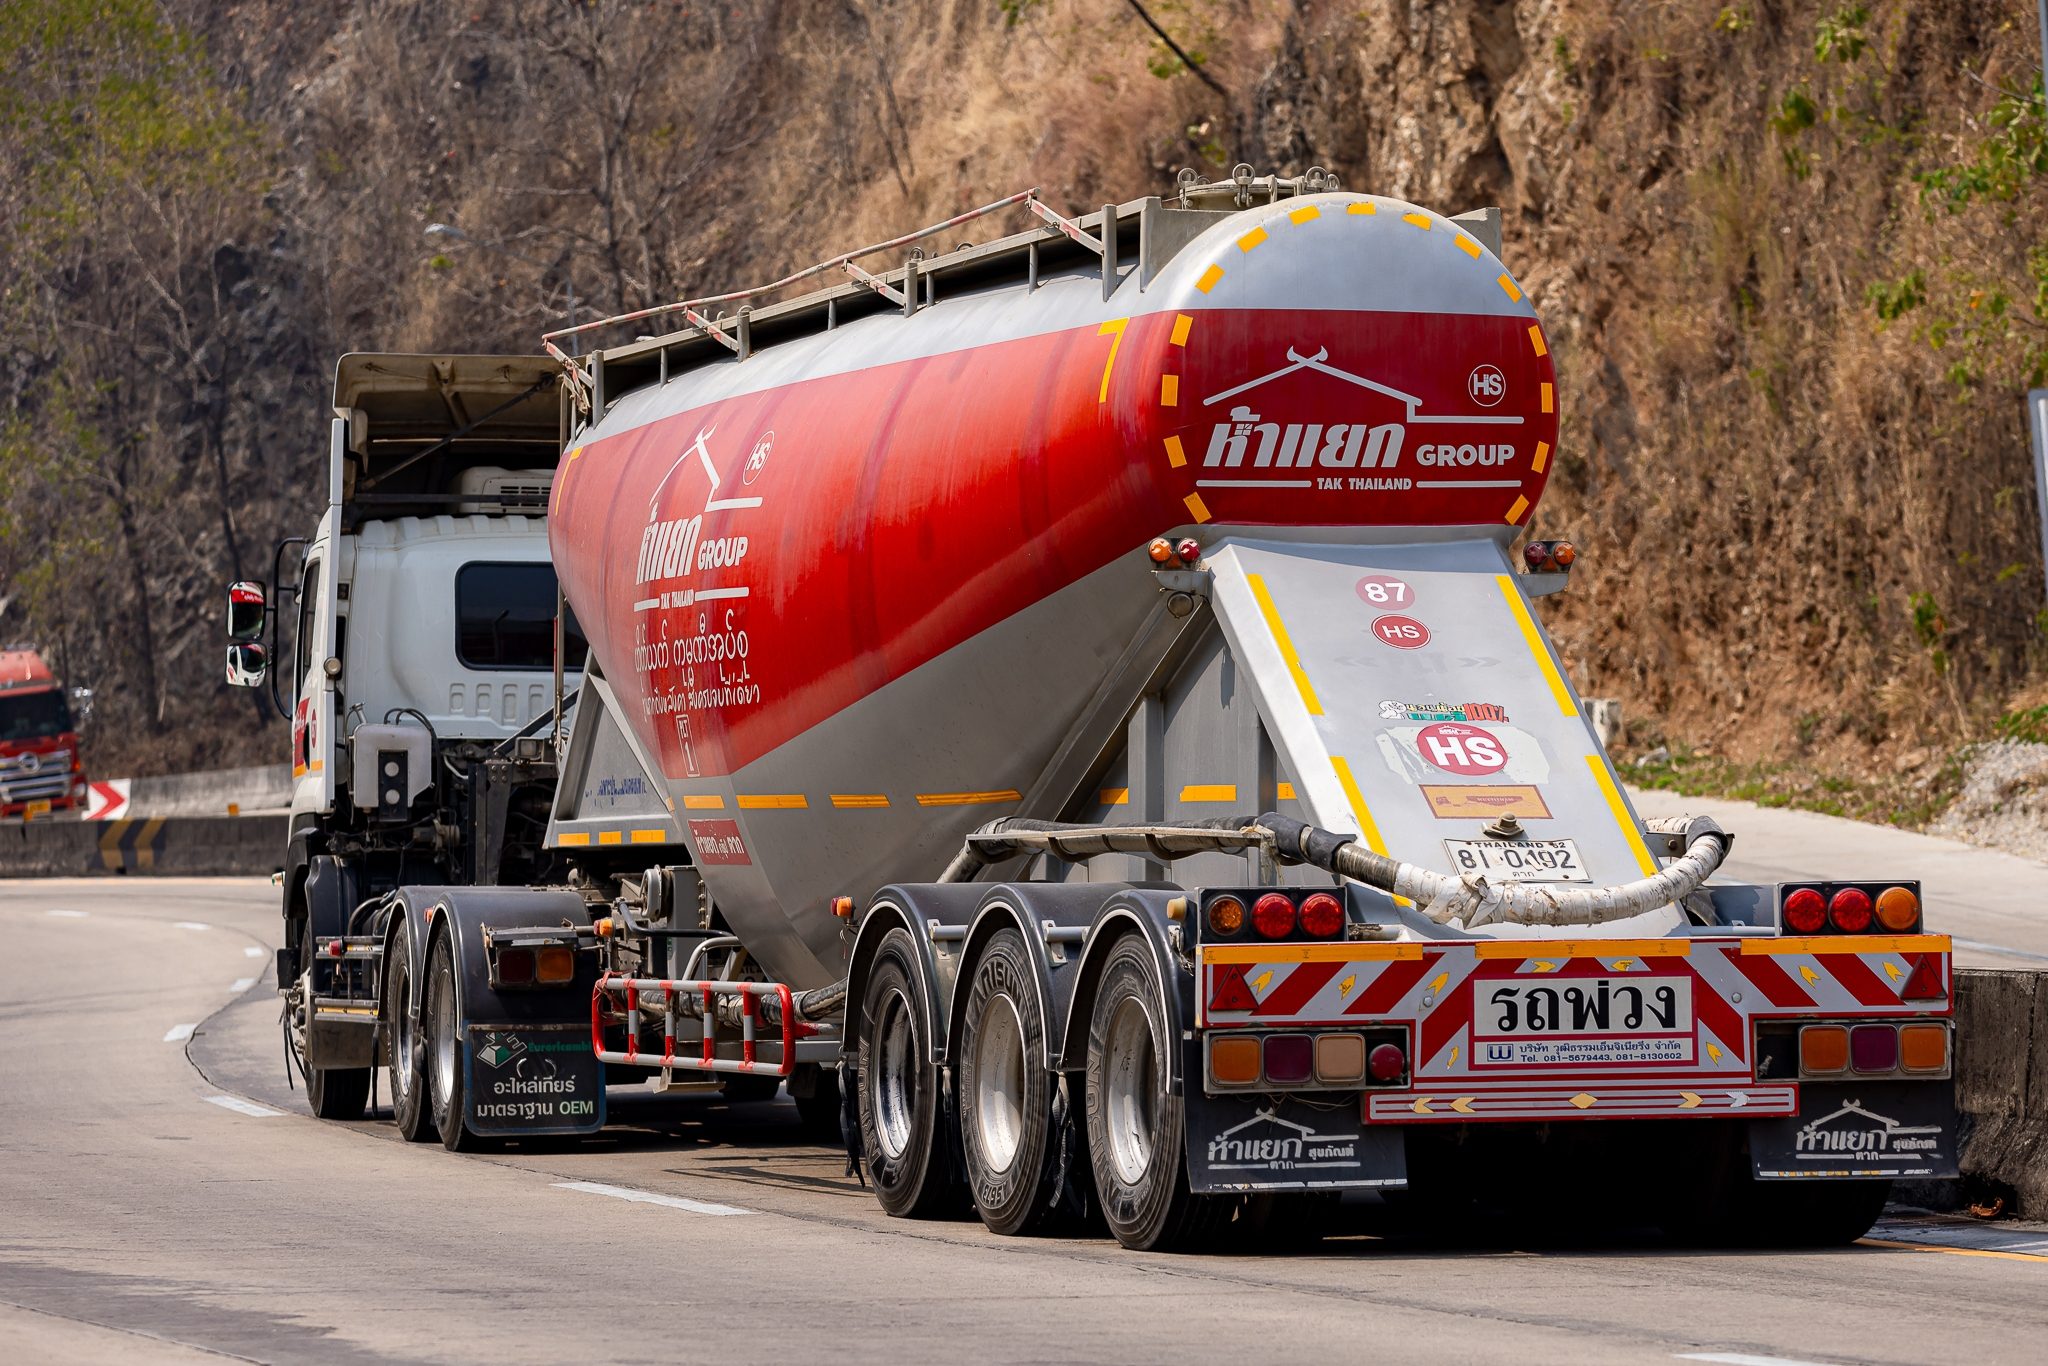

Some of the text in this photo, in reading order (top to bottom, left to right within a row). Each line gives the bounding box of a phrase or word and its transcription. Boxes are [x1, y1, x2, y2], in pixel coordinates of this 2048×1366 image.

[1203, 405, 1406, 468] ห้าแยก
[1416, 443, 1515, 466] GROUP
[1316, 477, 1412, 491] TAK THAILAND
[635, 502, 703, 586] ห้าแยก
[697, 536, 749, 571] GROUP
[1363, 582, 1406, 602] 87
[1381, 624, 1421, 639] HS
[1425, 736, 1505, 767] HS
[1474, 841, 1544, 849] THAILAND
[1491, 980, 1676, 1032] รถพ่วง
[1519, 1042, 1549, 1053] บริษัท
[1655, 1041, 1681, 1050] จำกัด
[1520, 1054, 1539, 1063] Tel.
[1616, 1052, 1682, 1061] 081-8130602
[494, 1074, 576, 1095] อะไหล่เกียร์
[477, 1101, 553, 1120] มาตราฐาน
[559, 1100, 594, 1115] OEM
[1796, 1124, 1889, 1151] ห้าแยก
[1207, 1135, 1303, 1161] ห้าแยก
[1855, 1151, 1880, 1161] ตาก
[1269, 1160, 1295, 1170] ตาก
